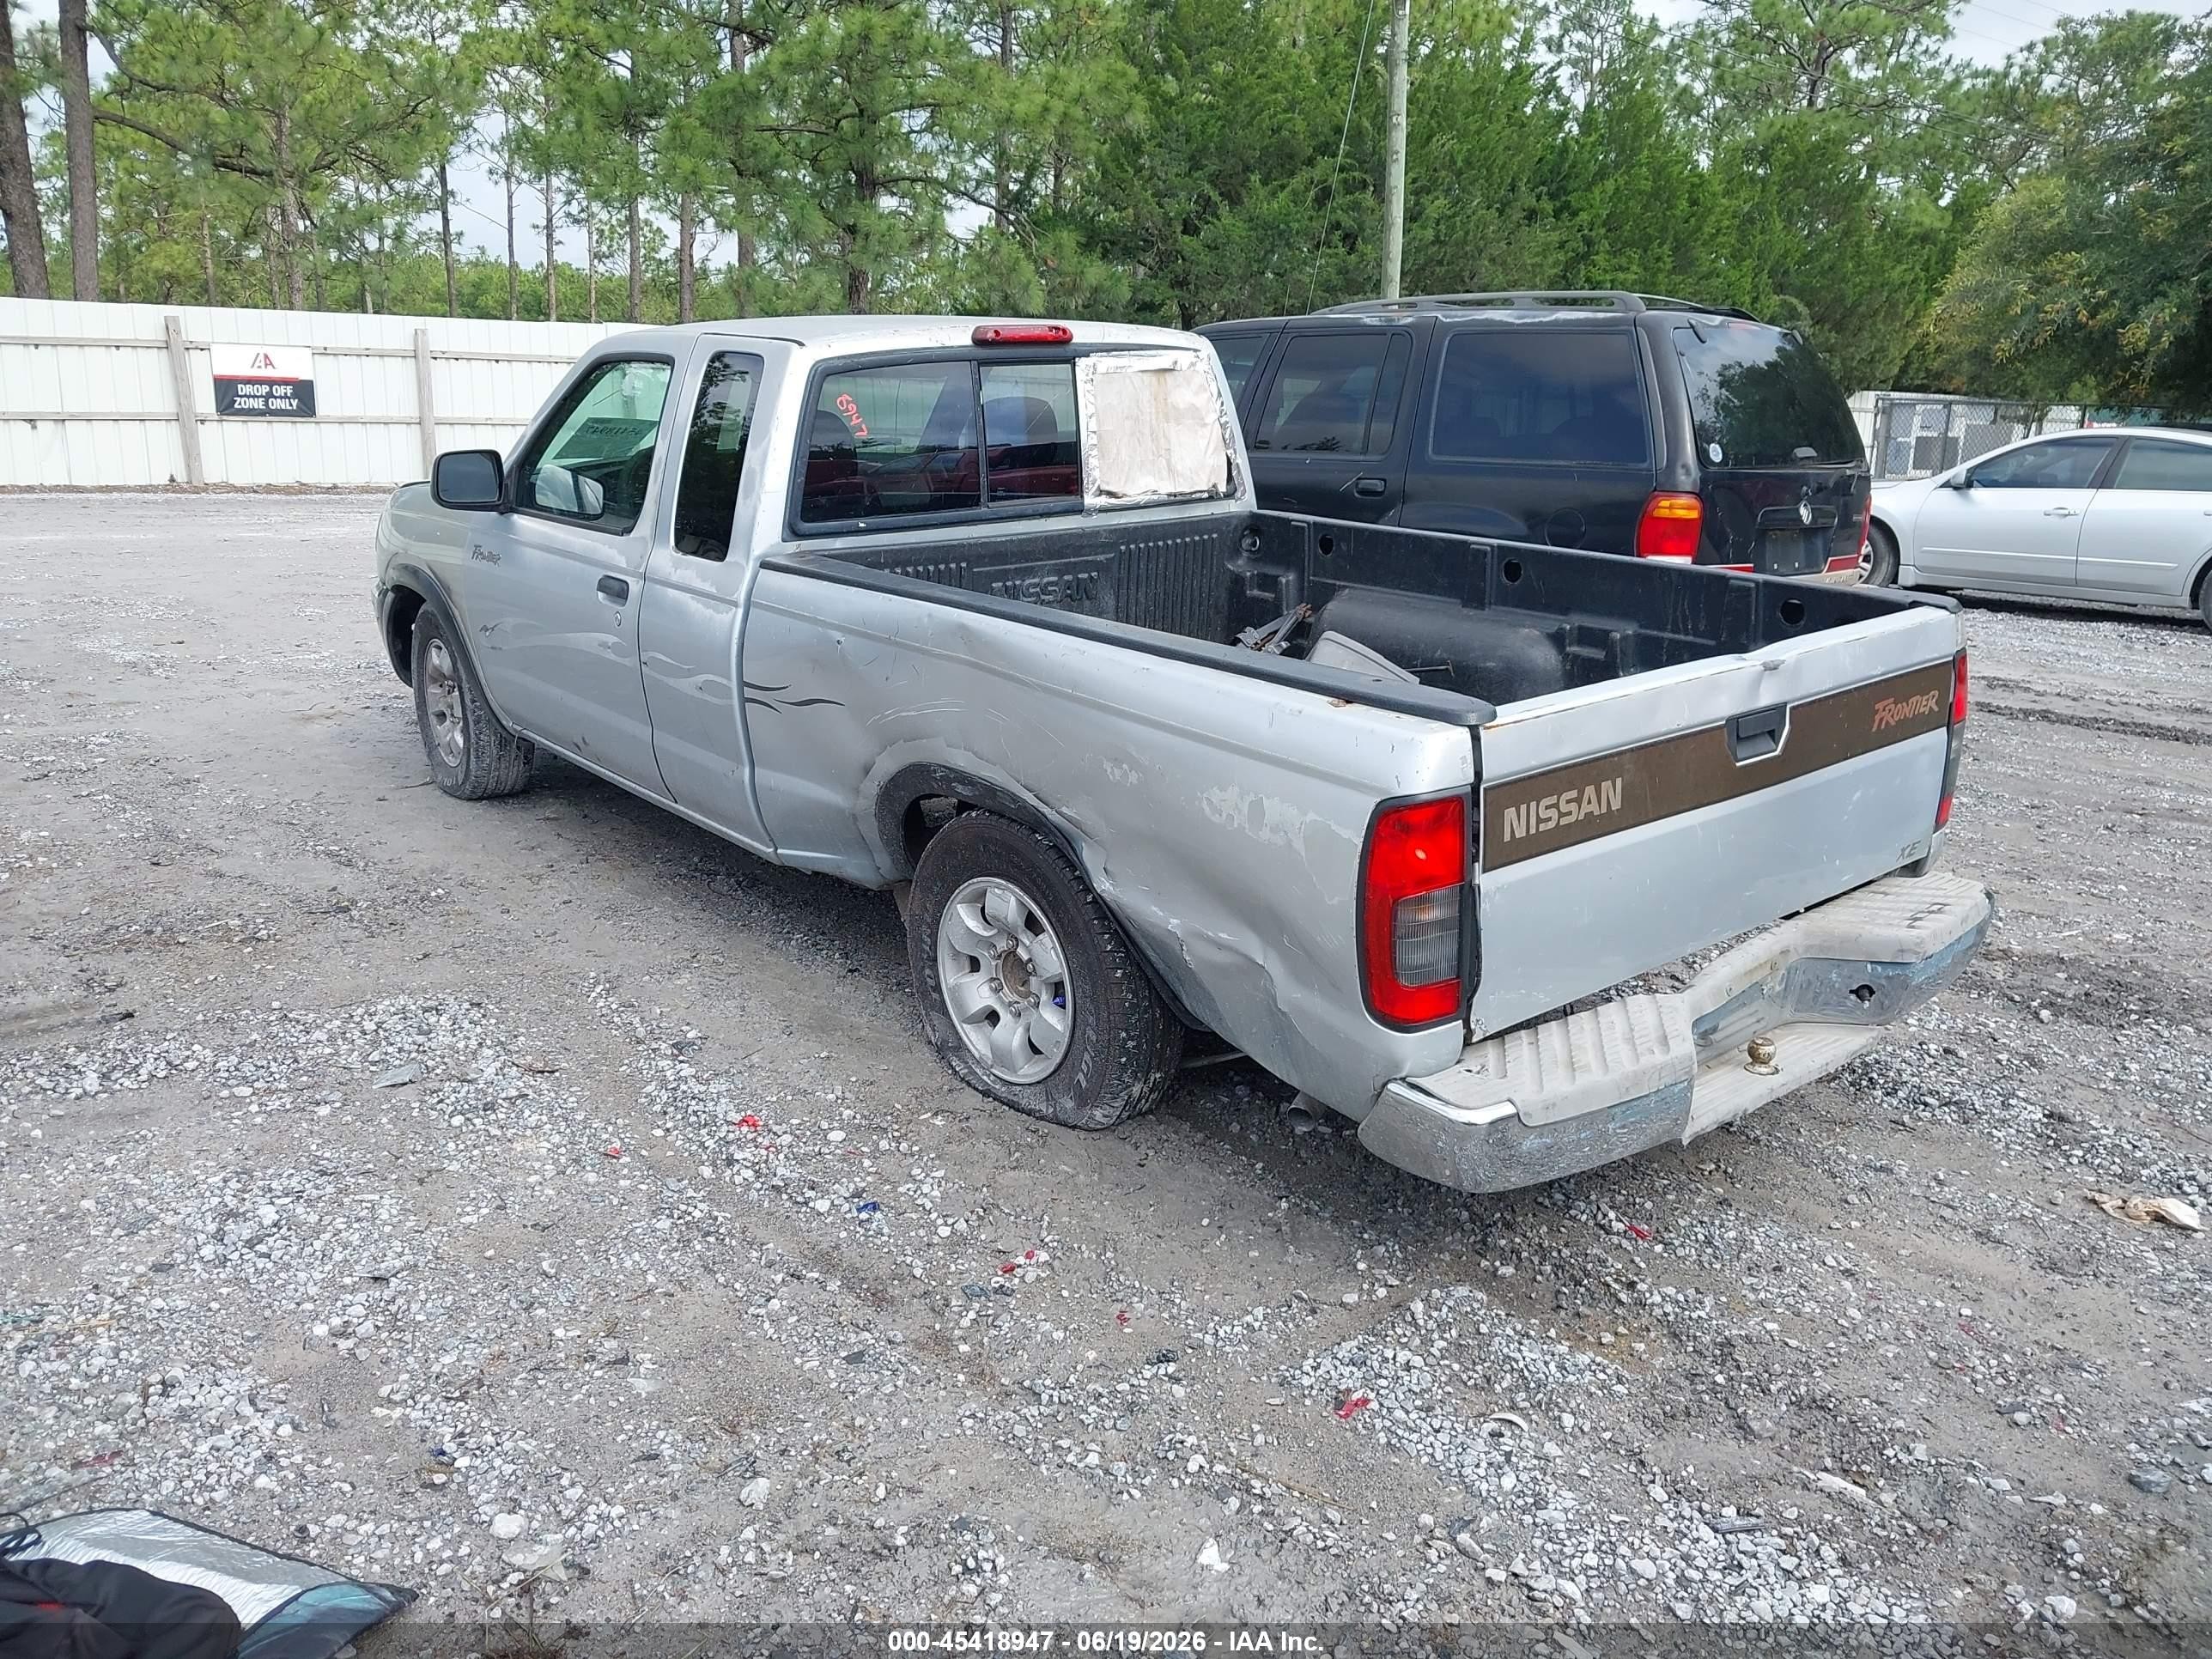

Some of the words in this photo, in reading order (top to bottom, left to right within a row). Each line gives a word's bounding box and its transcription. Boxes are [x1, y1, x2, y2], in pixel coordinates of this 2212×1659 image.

[233, 397, 266, 409] ZONE
[268, 398, 299, 410] ONLY
[237, 384, 270, 396] DROP
[272, 385, 294, 397] OFF
[989, 571, 1099, 604] NISSAN
[1872, 690, 1940, 732] FRONTIER
[1504, 776, 1622, 842] NISSAN
